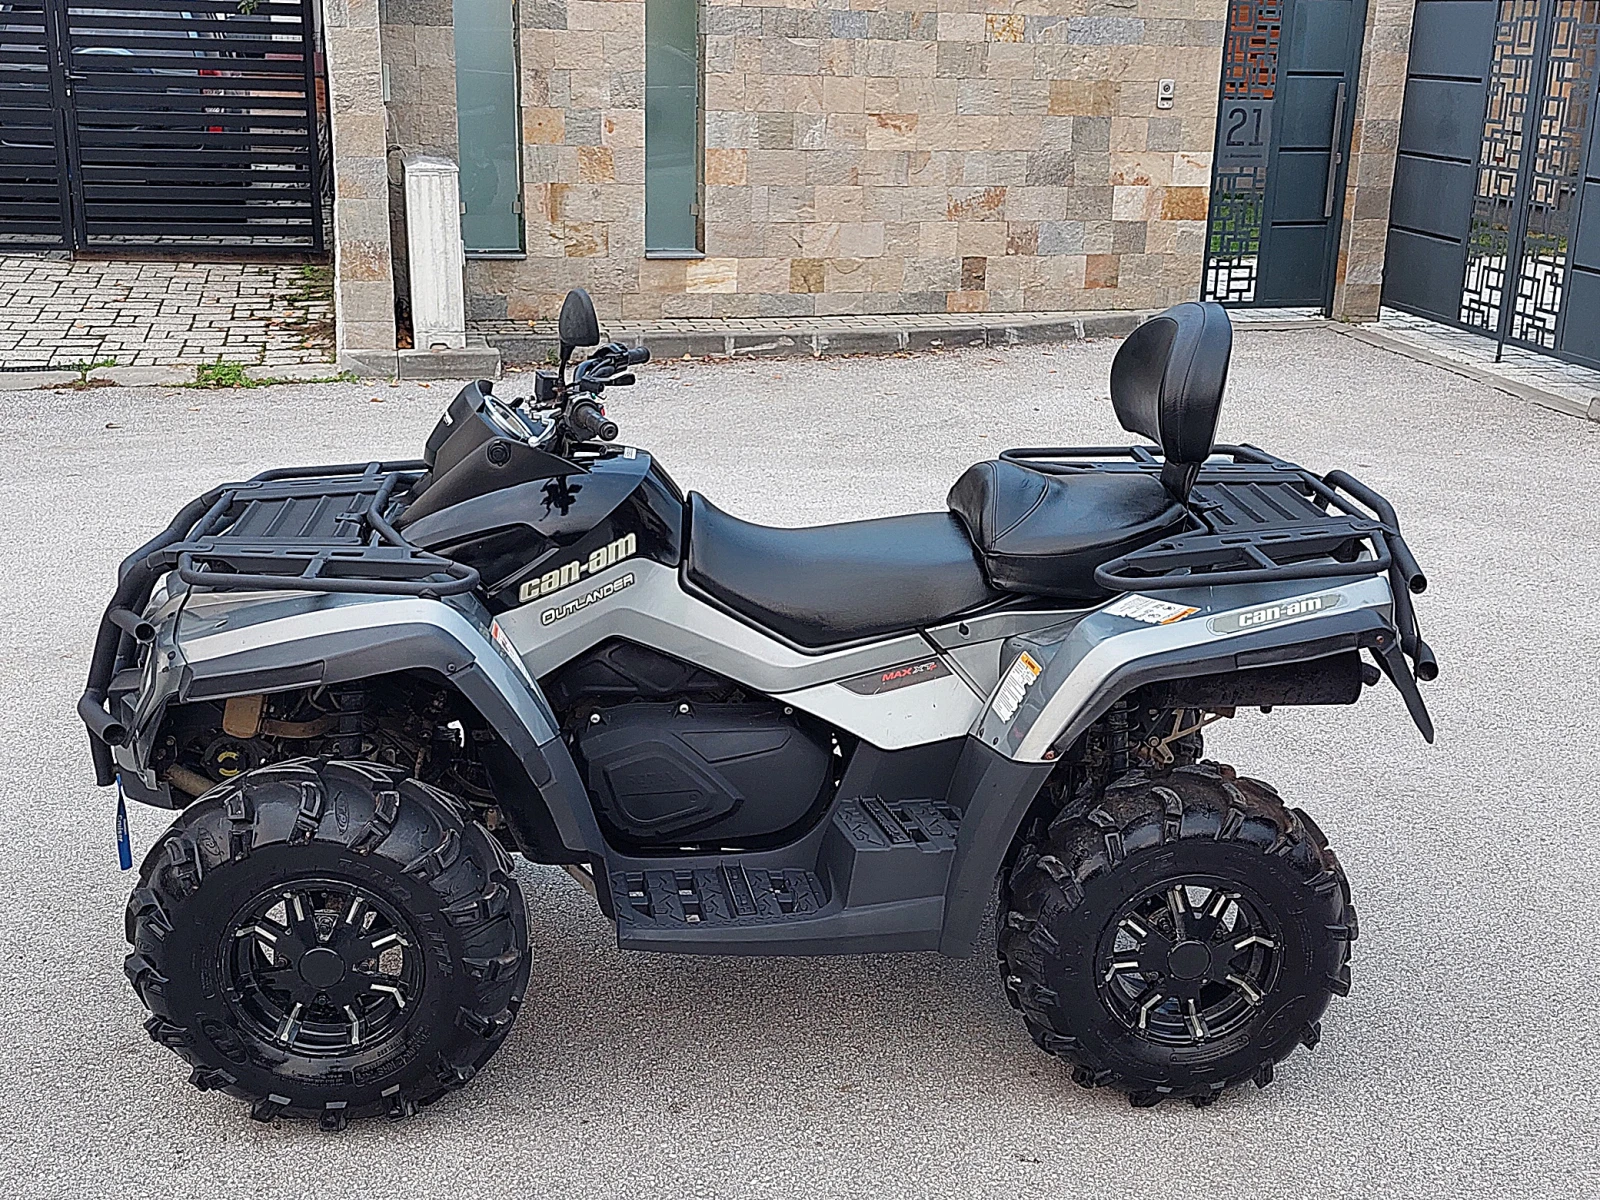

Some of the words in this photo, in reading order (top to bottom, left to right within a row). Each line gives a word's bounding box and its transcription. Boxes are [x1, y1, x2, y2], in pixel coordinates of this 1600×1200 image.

[1226, 107, 1263, 146] 21
[518, 532, 637, 603] can-am
[541, 572, 635, 626] OUTLANDER
[1239, 597, 1321, 627] can-am
[882, 667, 912, 682] MAX
